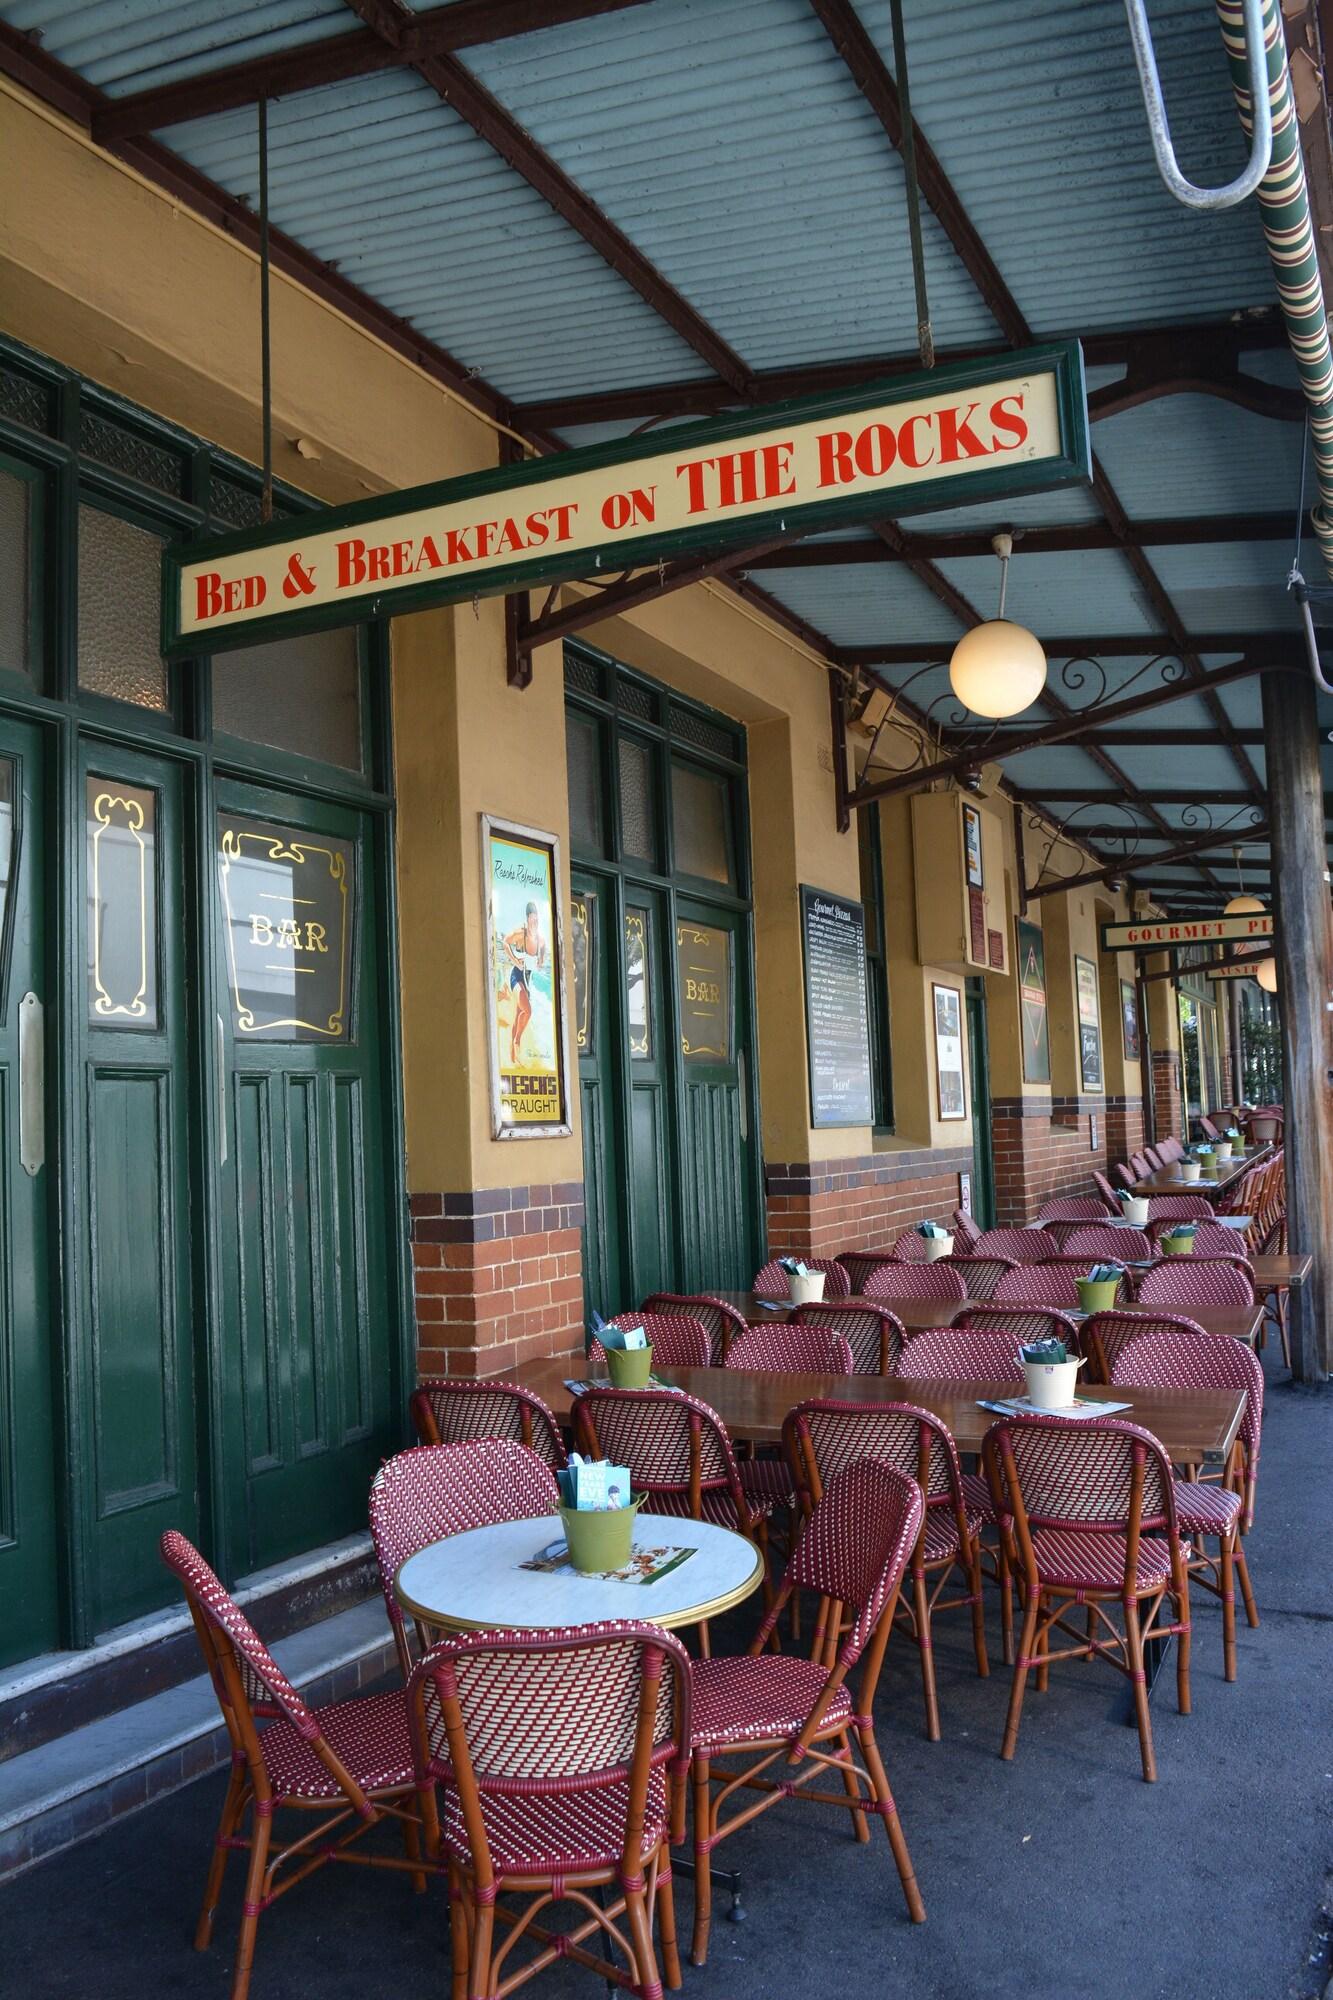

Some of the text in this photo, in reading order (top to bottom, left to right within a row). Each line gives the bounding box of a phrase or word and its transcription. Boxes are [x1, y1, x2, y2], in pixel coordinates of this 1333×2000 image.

[282, 553, 317, 597] &
[600, 485, 656, 530] ON
[676, 442, 797, 515] THE
[816, 394, 1028, 488] ROCKS
[248, 913, 329, 953] BAR
[1128, 919, 1274, 942] GOURMET PI
[685, 978, 720, 1005] BAR
